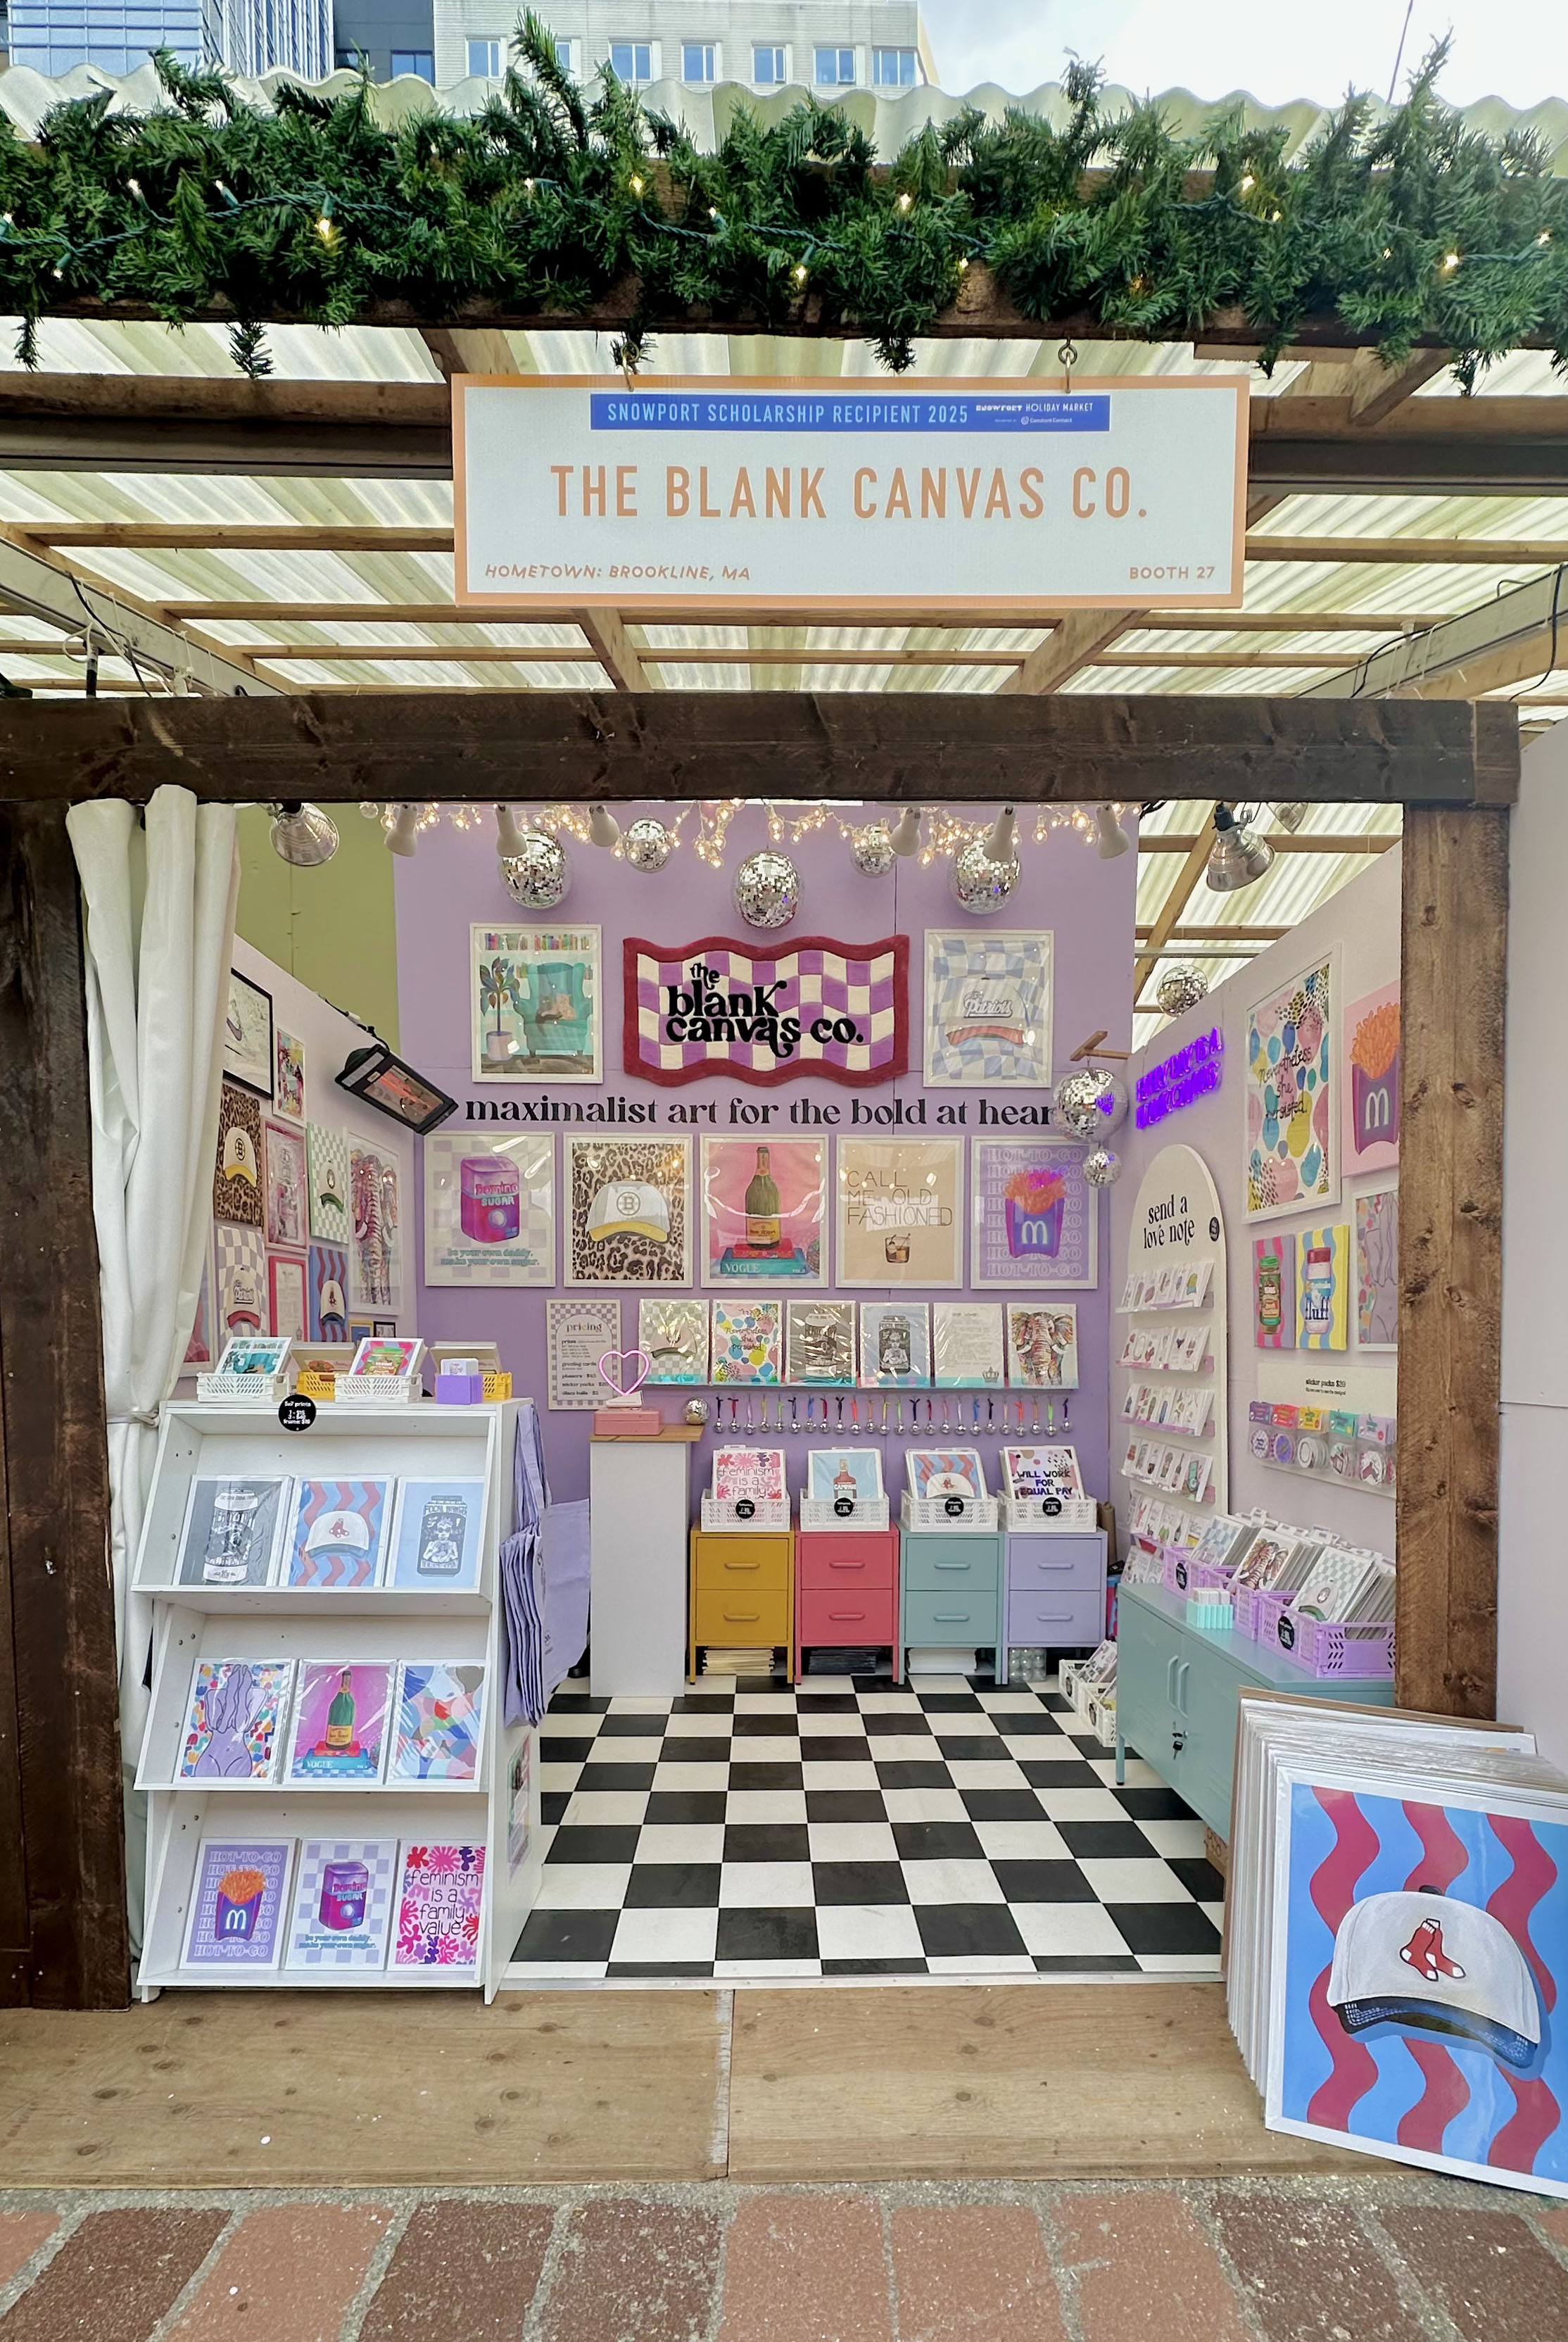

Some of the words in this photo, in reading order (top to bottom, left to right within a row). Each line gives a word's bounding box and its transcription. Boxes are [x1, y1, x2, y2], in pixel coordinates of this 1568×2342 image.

[608, 403, 700, 422] SNOWPORT
[708, 404, 824, 422] SCHOLARSHIP
[833, 405, 920, 423] RECIPIENT
[928, 405, 968, 424] 2025
[1025, 403, 1060, 412] HOLIDAY
[1063, 403, 1093, 412] MARKET
[550, 465, 638, 517] THE
[666, 466, 827, 518] BLANK
[854, 466, 1044, 519] CANVAS
[1073, 466, 1147, 519] CO.
[485, 564, 602, 579] HOMETOWN:
[609, 565, 714, 581] BROOKLINE,
[722, 566, 751, 581] MA
[1129, 566, 1189, 580] BOOTH
[1196, 566, 1215, 579] 27
[689, 962, 720, 990] the
[666, 979, 787, 1018] blank
[965, 999, 1012, 1016] Patriots
[666, 1016, 800, 1058] canvas
[811, 1018, 864, 1044] co.
[1258, 1044, 1311, 1088] nevertheless
[1276, 1074, 1293, 1098] she
[466, 1095, 658, 1124] maximalist
[669, 1099, 718, 1124] art
[729, 1097, 779, 1125] for
[790, 1098, 841, 1125] the
[851, 1098, 926, 1126] bold
[937, 1102, 968, 1125] at
[978, 1099, 1057, 1125] hear
[1265, 1088, 1307, 1132] persisted
[987, 1148, 1082, 1162] HOT-TO-GO
[847, 1170, 907, 1188] CALL
[476, 1181, 518, 1195] Domino
[481, 1196, 514, 1207] SUGAR
[848, 1190, 875, 1206] ME
[892, 1188, 932, 1206] OLD
[848, 1207, 952, 1226] FASHIONED
[1148, 1194, 1175, 1224] send
[1180, 1196, 1188, 1215] a
[1144, 1224, 1165, 1249] love
[1170, 1218, 1195, 1246] note
[460, 1249, 481, 1258] your
[467, 1258, 490, 1266] your
[724, 1263, 760, 1273] VOGUE
[987, 1263, 1082, 1277] HOT-TO-GO
[567, 1322, 602, 1333] pricing
[722, 1467, 774, 1477] feminism
[739, 1477, 748, 1485] is
[752, 1477, 759, 1485] a
[733, 1486, 766, 1497] family
[1056, 1487, 1073, 1495] PAY
[209, 1851, 282, 1863] HOT-TO-GO
[410, 1869, 479, 1887] feminism
[431, 1889, 443, 1902] is
[448, 1889, 457, 1902] a
[419, 1903, 464, 1924] family
[419, 1921, 462, 1935] value
[194, 1944, 267, 1957] HOT-TO-GO
